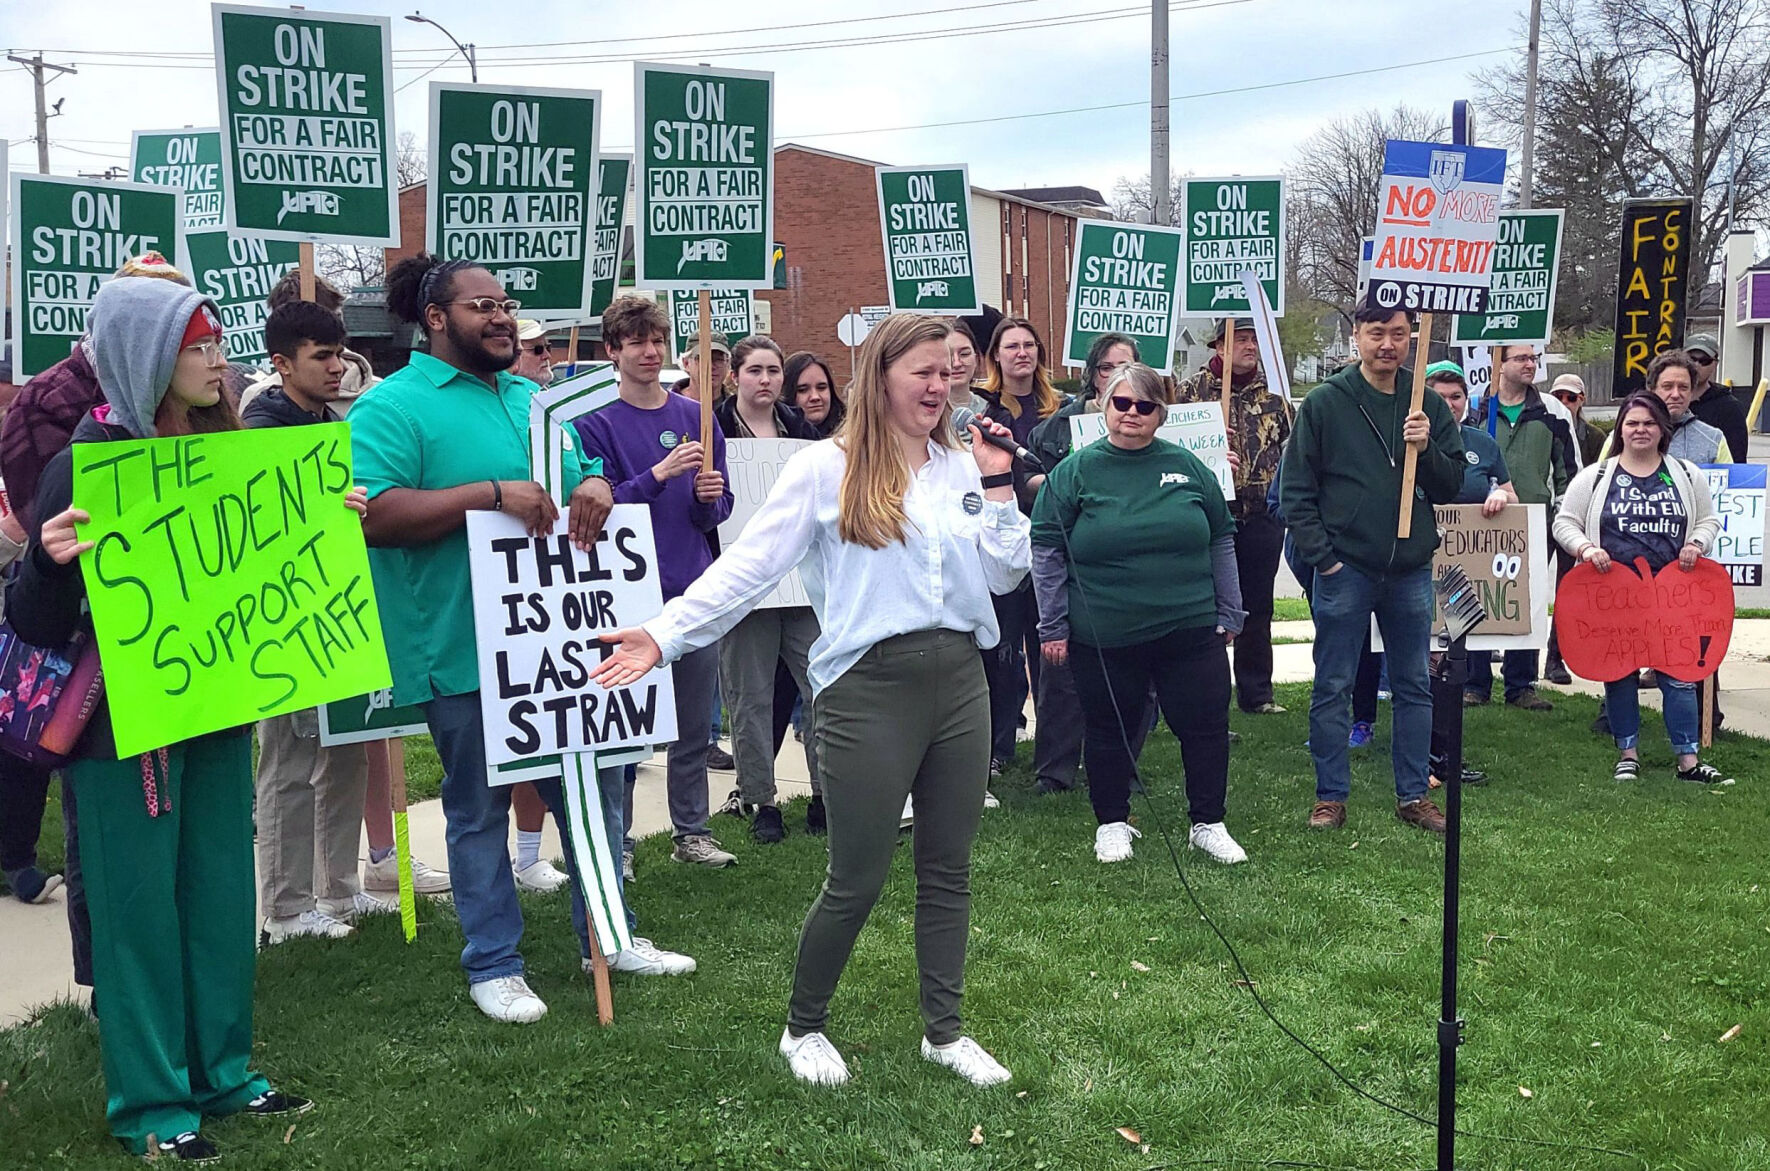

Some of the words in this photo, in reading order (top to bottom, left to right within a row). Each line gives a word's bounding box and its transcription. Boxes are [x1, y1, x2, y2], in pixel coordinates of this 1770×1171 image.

[274, 24, 325, 68] ON
[237, 64, 368, 114] STRIKE
[685, 80, 724, 121] ON
[236, 116, 286, 145] FOR
[296, 119, 313, 146] A
[320, 120, 377, 148] FAIR
[491, 100, 539, 143] ON
[167, 138, 198, 164] ON
[653, 120, 755, 163] STRIKE
[141, 164, 218, 191] STRIKE
[242, 152, 377, 185] CONTRACT
[450, 143, 574, 188] STRIKE
[1432, 159, 1464, 177] IFT
[650, 170, 689, 197] FOR
[697, 171, 710, 196] A
[717, 170, 760, 198] FAIR
[908, 175, 935, 202] ON
[1216, 185, 1247, 210] ON
[71, 191, 120, 231] ON
[186, 194, 219, 214] FAIR
[445, 196, 493, 224] FOR
[502, 195, 519, 223] A
[527, 194, 579, 222] FAIR
[652, 204, 759, 232] CONTRACT
[890, 203, 959, 230] STRIKE
[1386, 185, 1436, 218] NO
[1438, 190, 1499, 224] MORE
[1193, 211, 1270, 236] STRIKE
[1497, 219, 1526, 243] ON
[227, 237, 269, 266] ON
[447, 231, 577, 261] CONTRACT
[595, 231, 616, 252] AIR
[892, 235, 917, 255] FOR
[922, 236, 931, 253] A
[935, 233, 966, 253] FAIR
[1112, 232, 1145, 260] ON
[1191, 242, 1220, 259] FOR
[1225, 241, 1236, 257] A
[1240, 240, 1273, 257] FAIR
[1375, 235, 1495, 274] AUSTERITY
[896, 256, 966, 278] CONTRACT
[1494, 244, 1546, 269] RIKE
[29, 272, 78, 299] FOR
[204, 262, 299, 300] STRIK
[1084, 256, 1167, 290] STRIKE
[1499, 273, 1509, 289] A
[1514, 271, 1547, 289] FAIR
[1653, 210, 1681, 357] CONTRAC
[718, 299, 745, 314] FAIR
[1079, 289, 1111, 307] FOR
[1116, 291, 1127, 308] A
[1132, 292, 1167, 309] FAIR
[1380, 288, 1398, 302] ON
[1405, 284, 1481, 312] STRIKE
[1486, 292, 1545, 311] NTRACT
[1623, 215, 1657, 378] FAIR
[220, 305, 248, 328] OR
[255, 303, 268, 324] A
[680, 317, 745, 334] CORACT
[1079, 311, 1166, 334] CONTRACT
[1166, 410, 1212, 424] EACHERS
[727, 441, 755, 462] OU
[1189, 434, 1227, 451] WEEK
[81, 438, 213, 517] THE
[1620, 487, 1625, 500] I
[1611, 502, 1657, 516] With
[1660, 502, 1686, 517] EIU
[1618, 517, 1680, 538] Faculty
[95, 439, 351, 646] STUDENTS
[1445, 529, 1526, 557] EDUCATORS
[491, 527, 647, 587] THIS
[1576, 580, 1716, 611] Teachers
[153, 530, 330, 696] SUPPORT
[502, 592, 551, 636] IS
[562, 590, 617, 631] OUR
[1576, 619, 1640, 640] Deserve
[1644, 617, 1683, 637] More
[1686, 614, 1728, 635] Than
[250, 575, 371, 712] STAFF
[505, 684, 657, 755] STRAW
